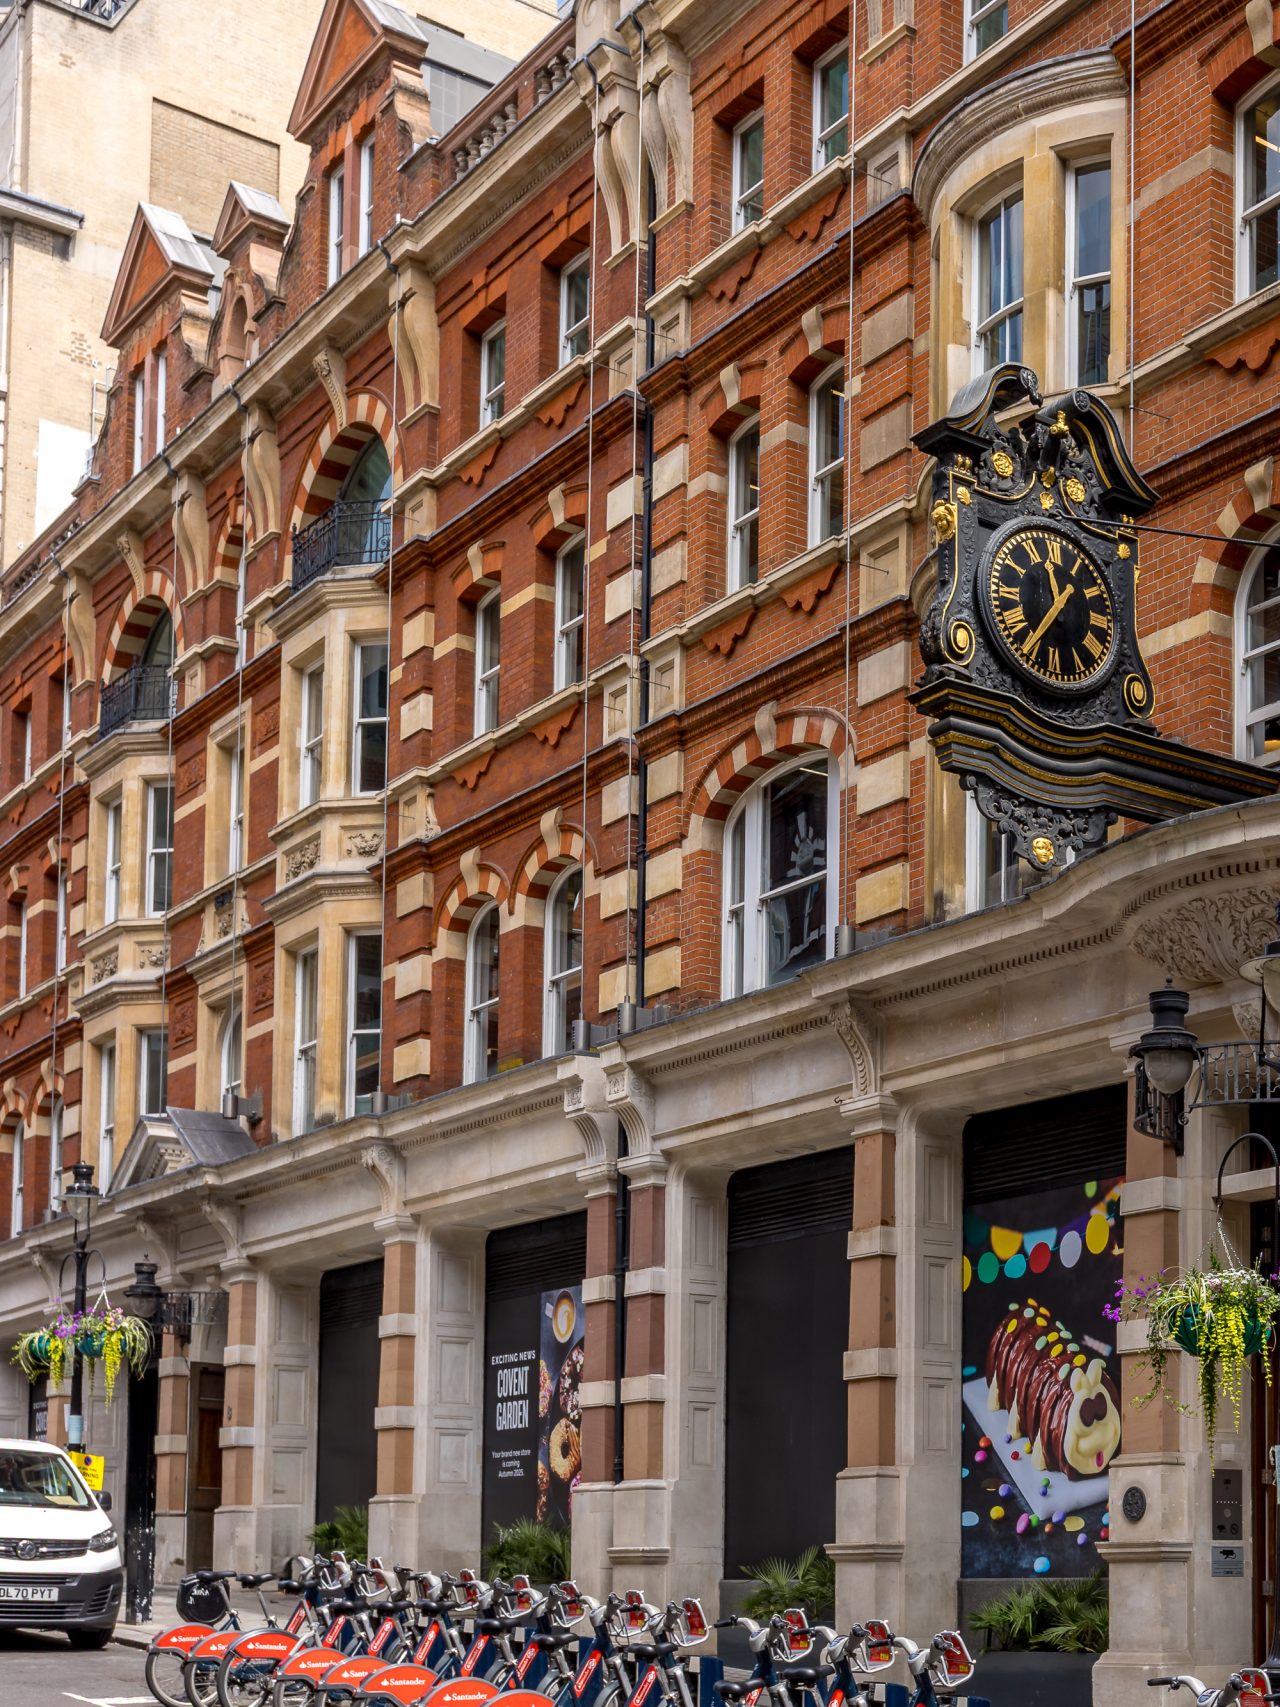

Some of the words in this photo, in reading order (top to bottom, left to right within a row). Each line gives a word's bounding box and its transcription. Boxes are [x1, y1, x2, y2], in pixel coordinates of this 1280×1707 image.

[1021, 539, 1042, 565] XI
[1046, 540, 1062, 566] XII
[1084, 586, 1100, 599] II
[1090, 610, 1108, 630] III
[491, 1352, 518, 1365] EXCITING
[519, 1350, 536, 1361] NEWS
[497, 1366, 530, 1398] COVENT
[36, 1411, 48, 1433] COVE
[496, 1400, 529, 1431] GARDEN
[32, 1588, 54, 1599] PYT
[254, 1642, 288, 1650] Santander
[389, 1678, 426, 1686] Santander
[452, 1692, 488, 1701] Santander
